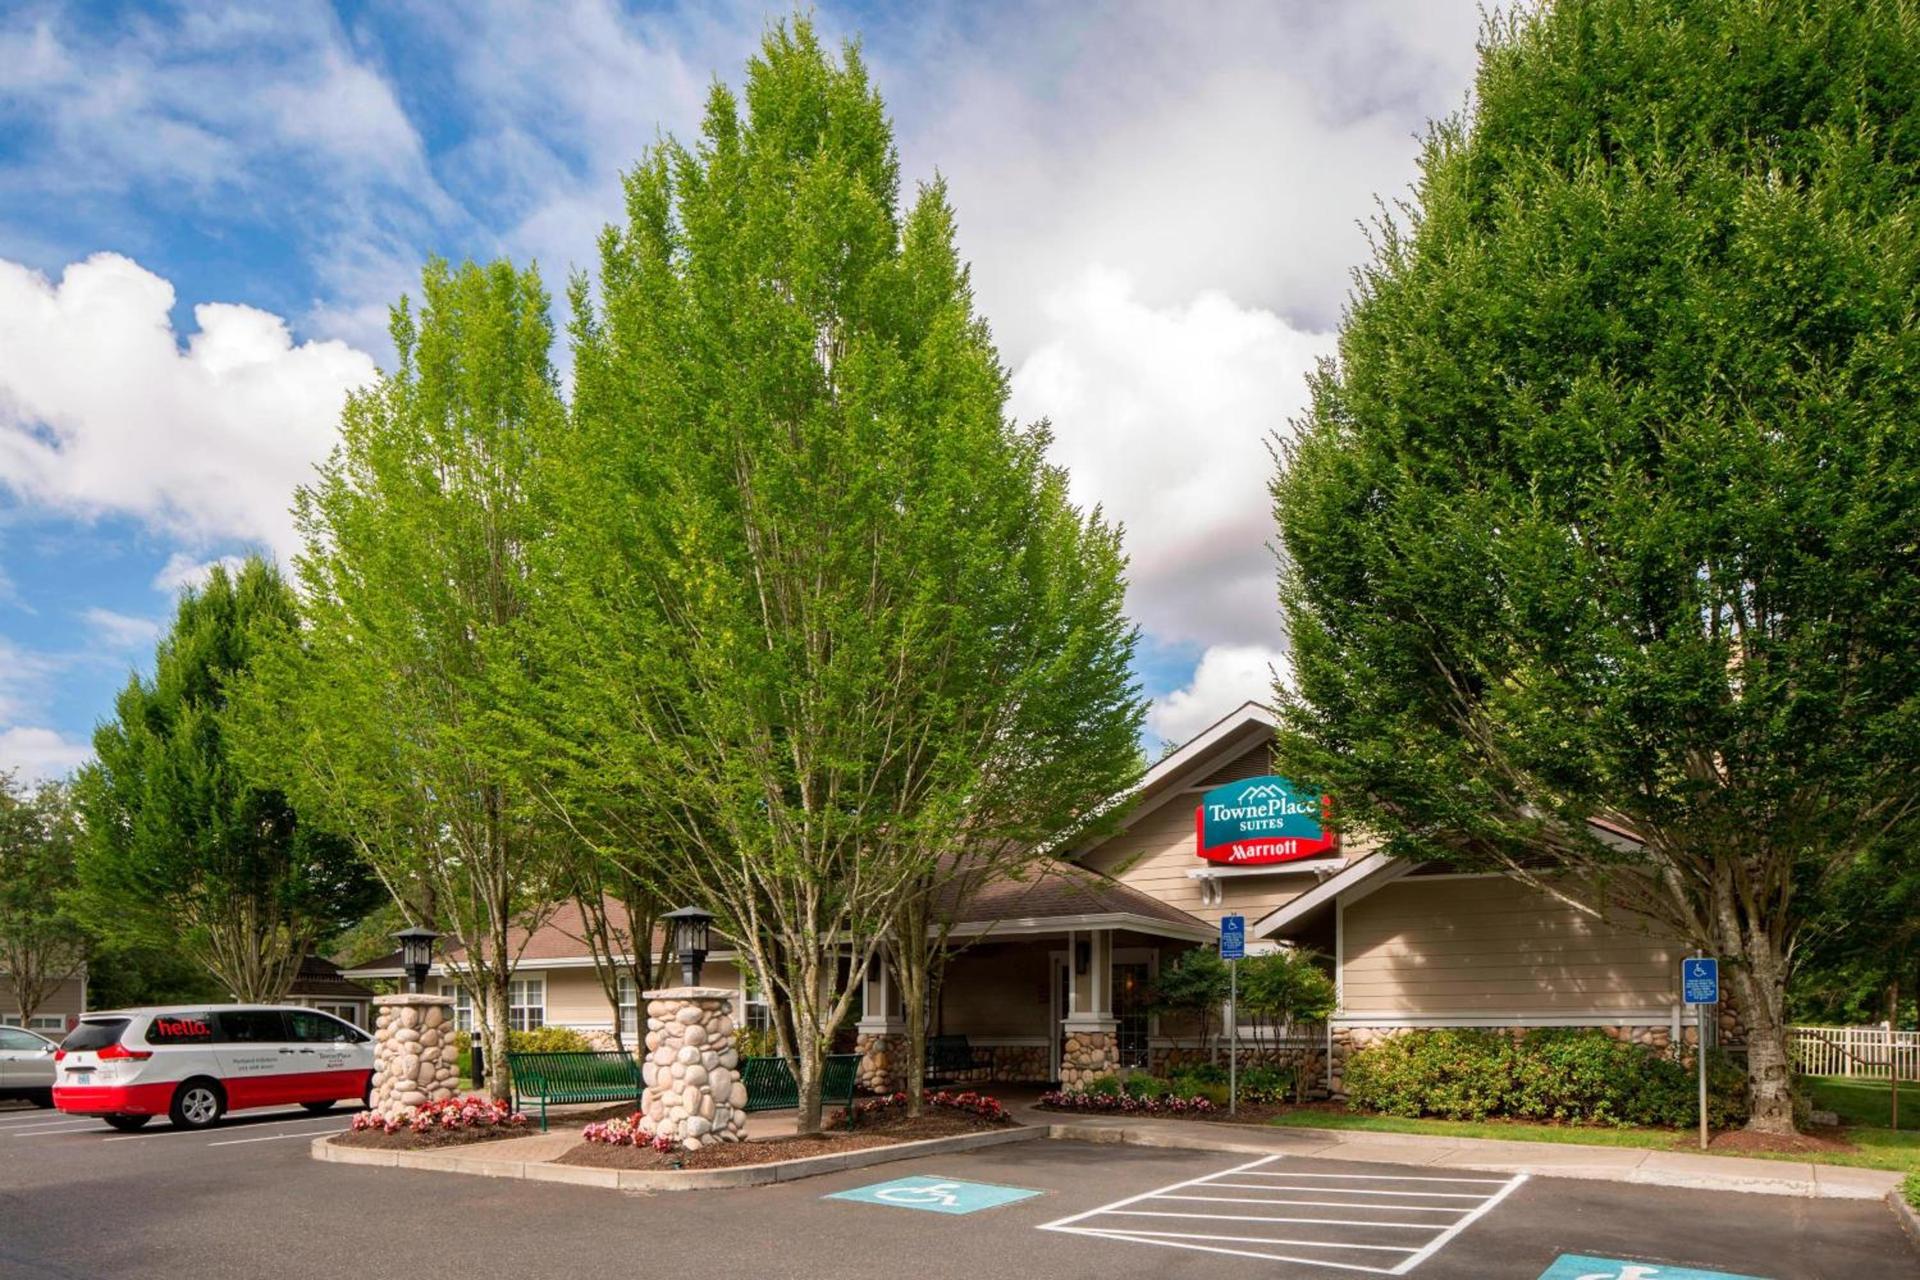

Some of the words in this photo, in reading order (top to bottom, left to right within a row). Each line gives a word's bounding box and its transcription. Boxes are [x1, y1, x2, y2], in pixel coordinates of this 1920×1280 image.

[1209, 798, 1315, 822] TownePlace
[1240, 818, 1284, 831] SUITES
[1229, 840, 1298, 861] Marriott
[157, 1018, 211, 1036] hello.
